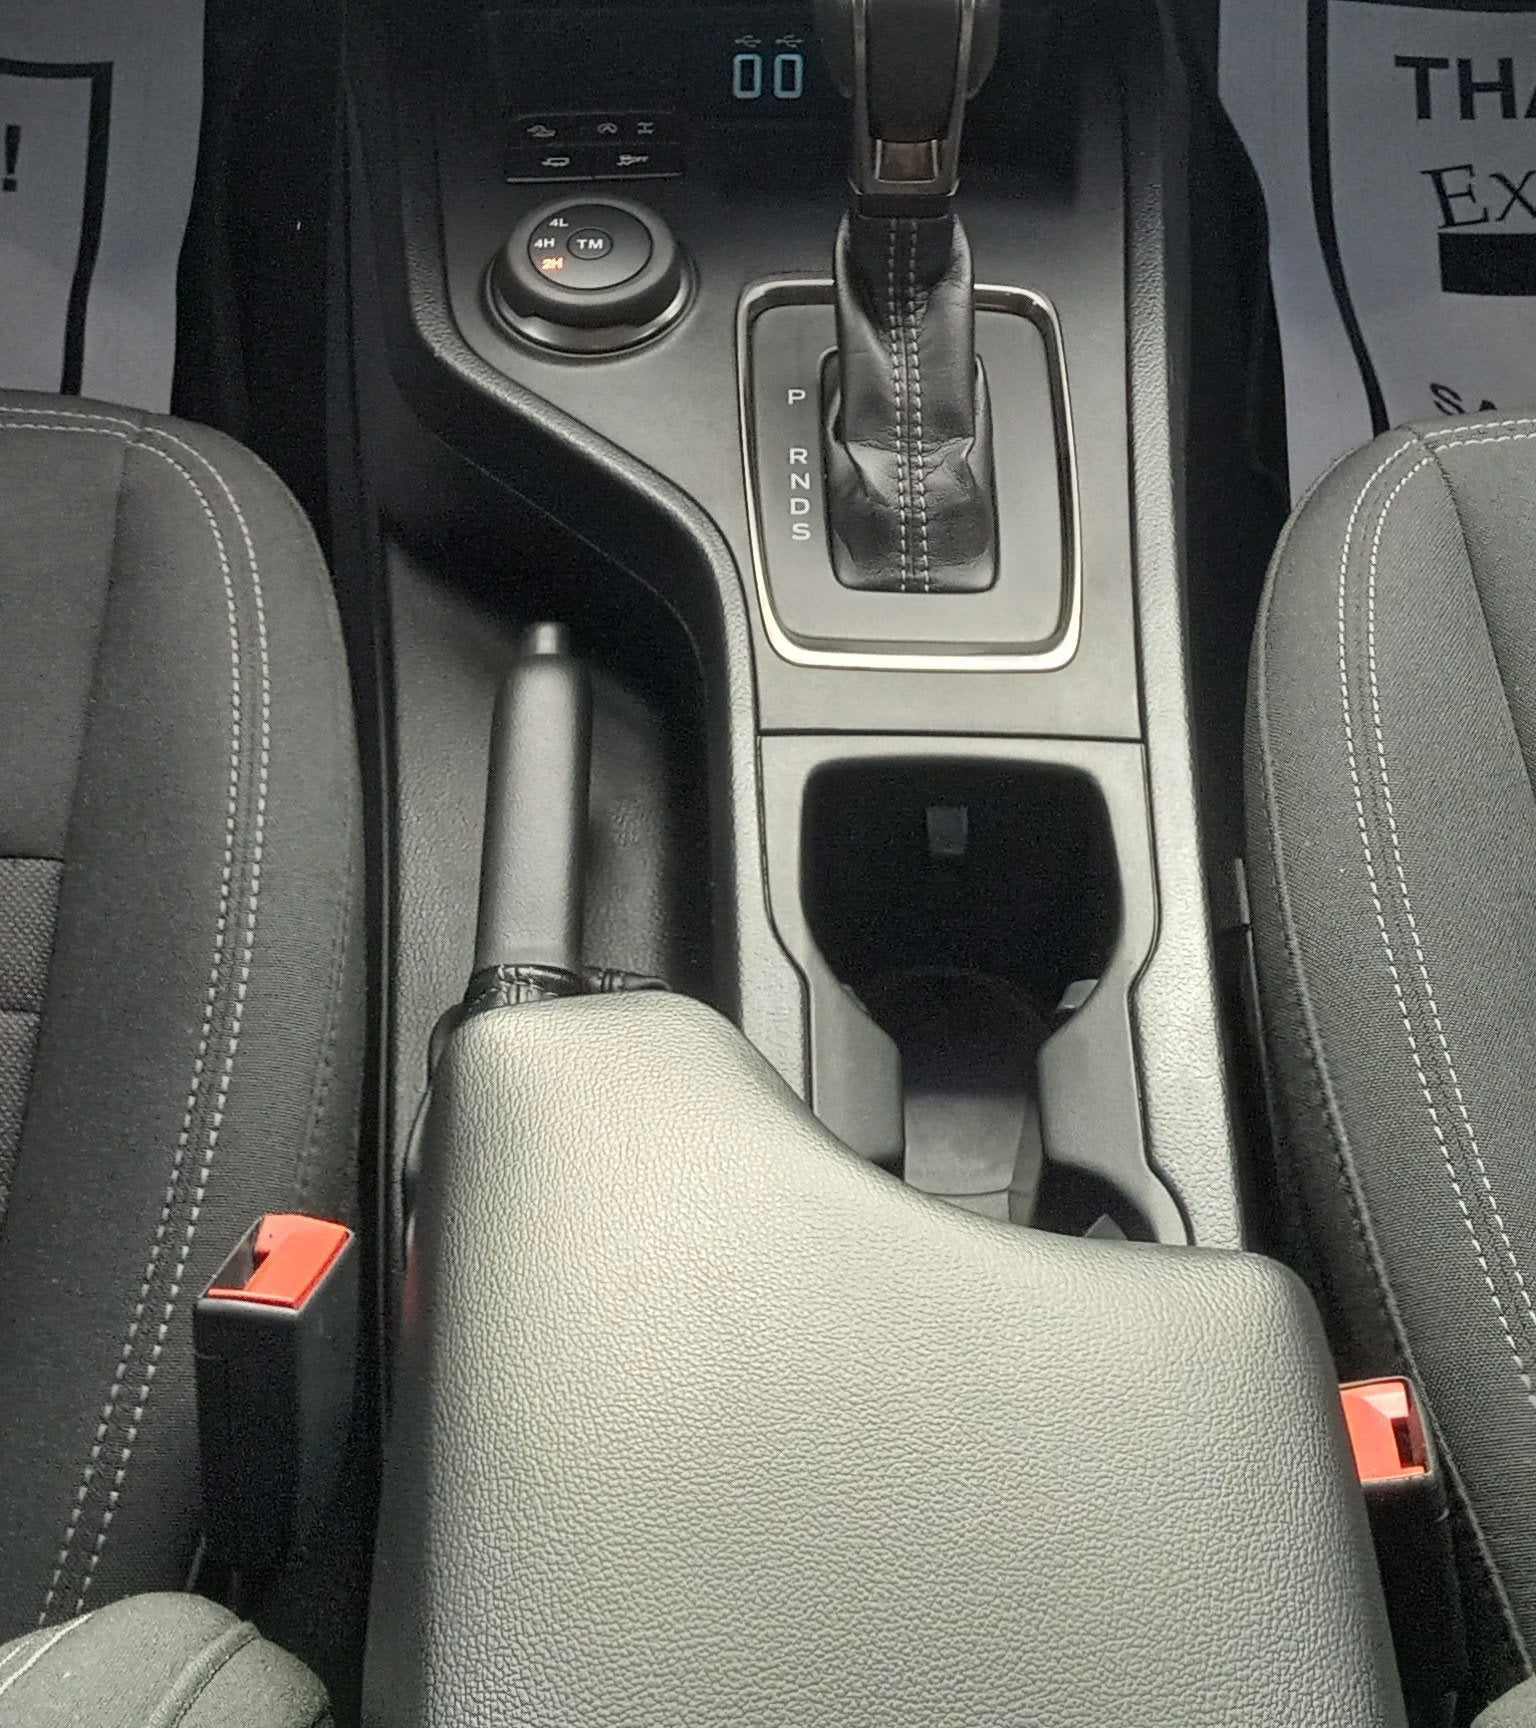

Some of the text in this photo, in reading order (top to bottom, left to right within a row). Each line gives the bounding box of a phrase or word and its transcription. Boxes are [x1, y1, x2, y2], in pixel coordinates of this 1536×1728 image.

[549, 218, 569, 228] 4L
[533, 237, 555, 250] 4H
[576, 238, 604, 250] TM
[786, 388, 807, 406] P
[788, 447, 809, 466] R
[789, 472, 812, 491] N
[789, 497, 811, 516] D
[790, 522, 812, 541] S
